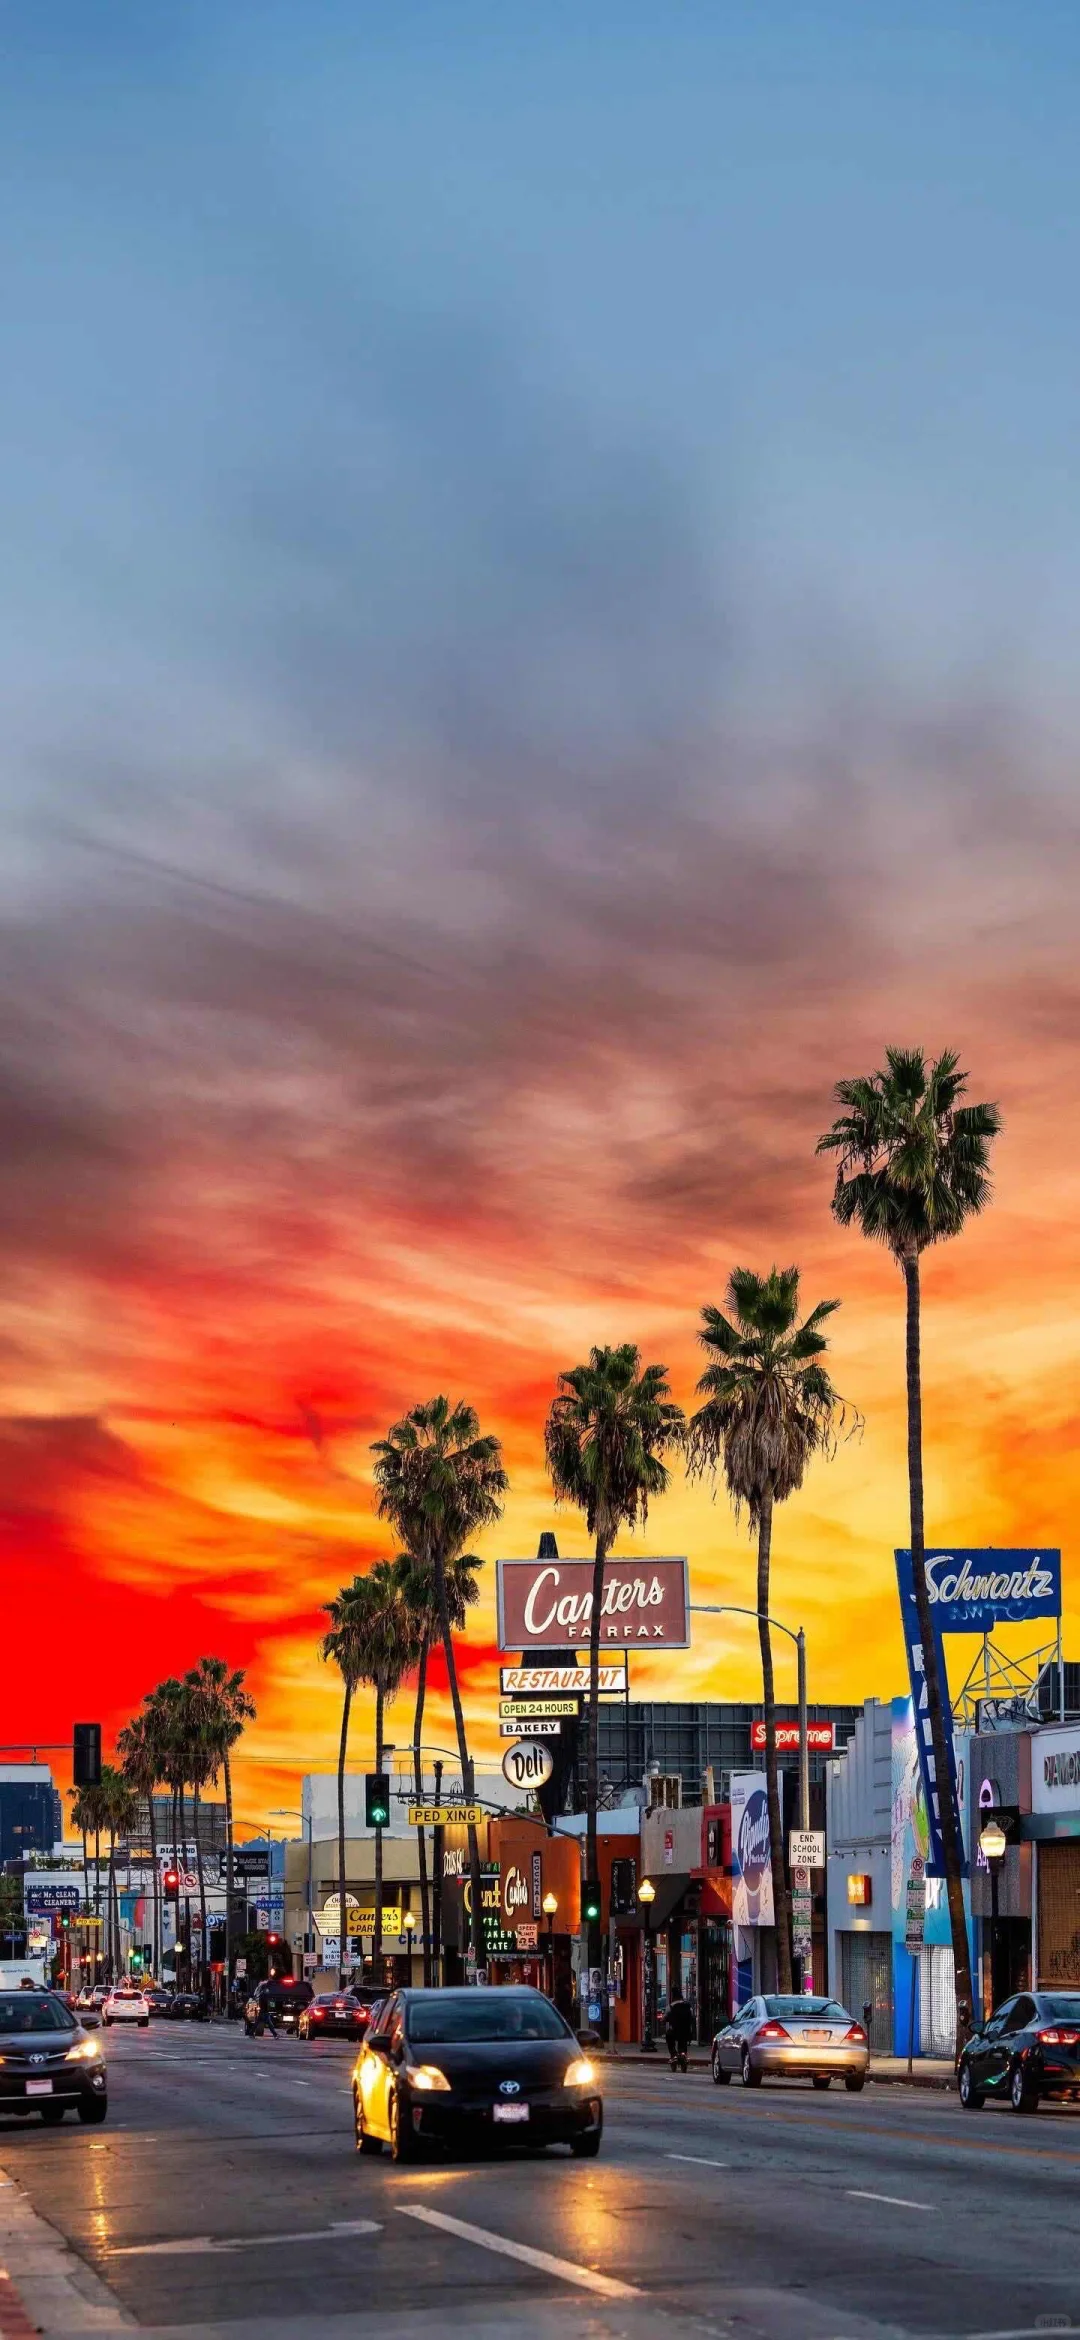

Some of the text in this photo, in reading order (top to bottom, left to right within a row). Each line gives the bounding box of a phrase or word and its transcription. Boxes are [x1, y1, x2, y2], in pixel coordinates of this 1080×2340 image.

[910, 1556, 1054, 1604] Schwartz
[524, 1567, 665, 1635] Canters
[568, 1625, 664, 1638] FARFAX
[504, 1702, 574, 1714] OPEN 24 HOURS
[506, 1723, 557, 1733] BAKERY
[511, 1746, 544, 1781] Deli
[415, 1810, 476, 1821] PED XING
[793, 1845, 821, 1853] SCHOOL
